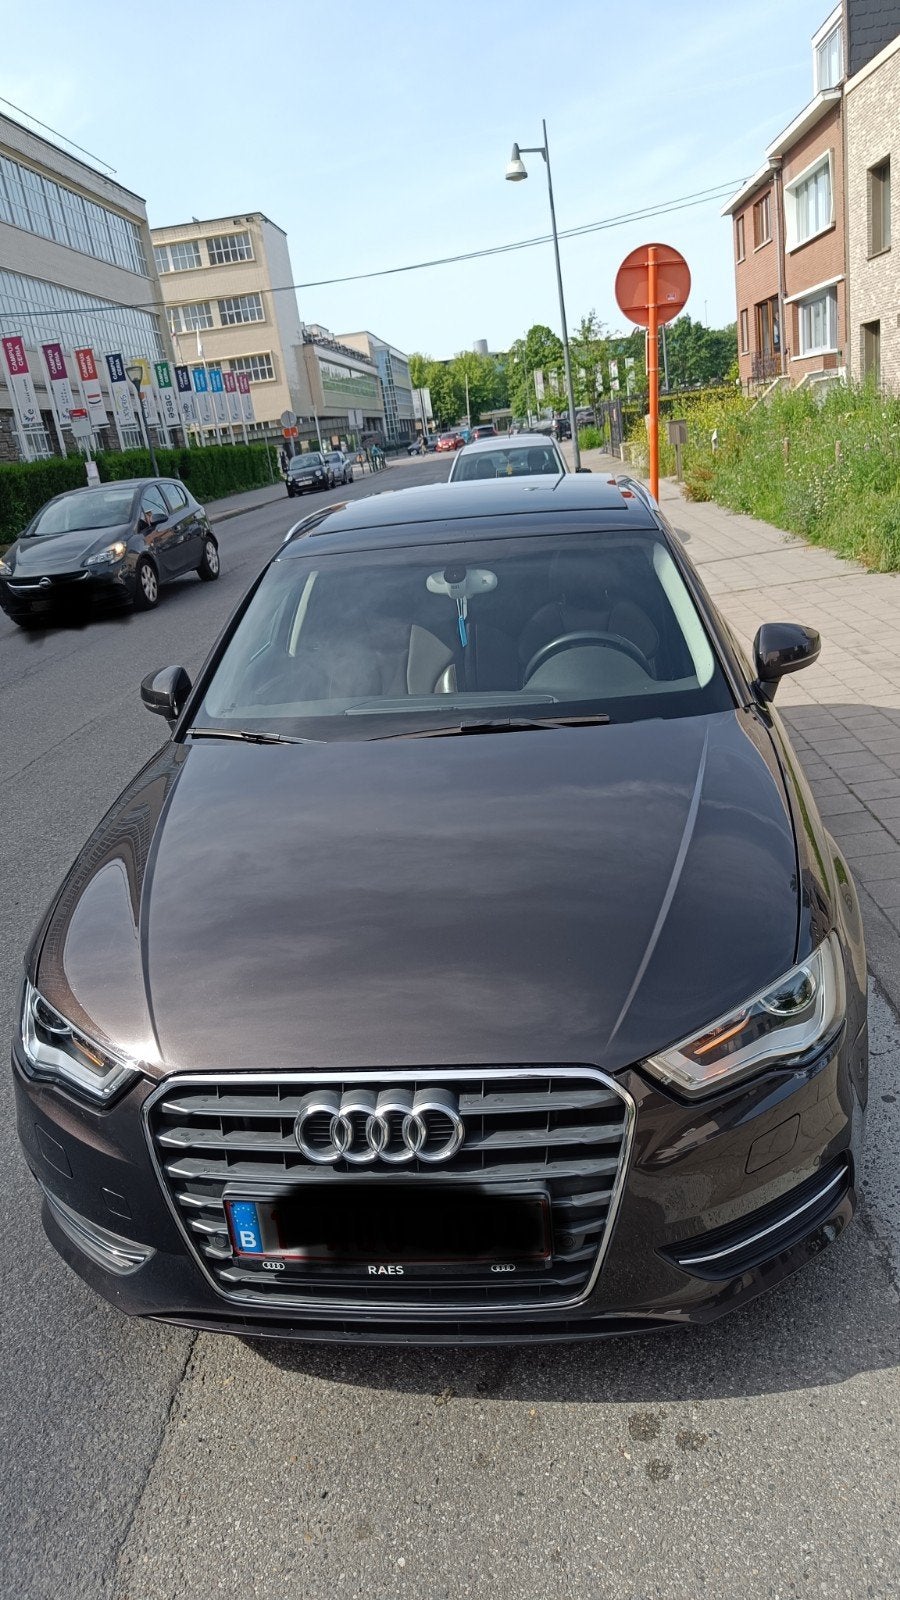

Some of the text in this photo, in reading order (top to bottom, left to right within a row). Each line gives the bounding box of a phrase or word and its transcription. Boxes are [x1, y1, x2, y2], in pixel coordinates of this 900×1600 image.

[7, 342, 18, 371] CAMPUS
[15, 344, 24, 366] CERIA
[47, 349, 57, 374] CAMPUS
[54, 351, 62, 370] CERIA
[79, 352, 89, 378] CAMPUS
[85, 354, 94, 374] CERIA
[108, 356, 118, 380] CAMPUS
[115, 358, 123, 376] CERIA
[164, 394, 175, 419] esac
[240, 1230, 257, 1248] B
[368, 1265, 404, 1276] RAES
